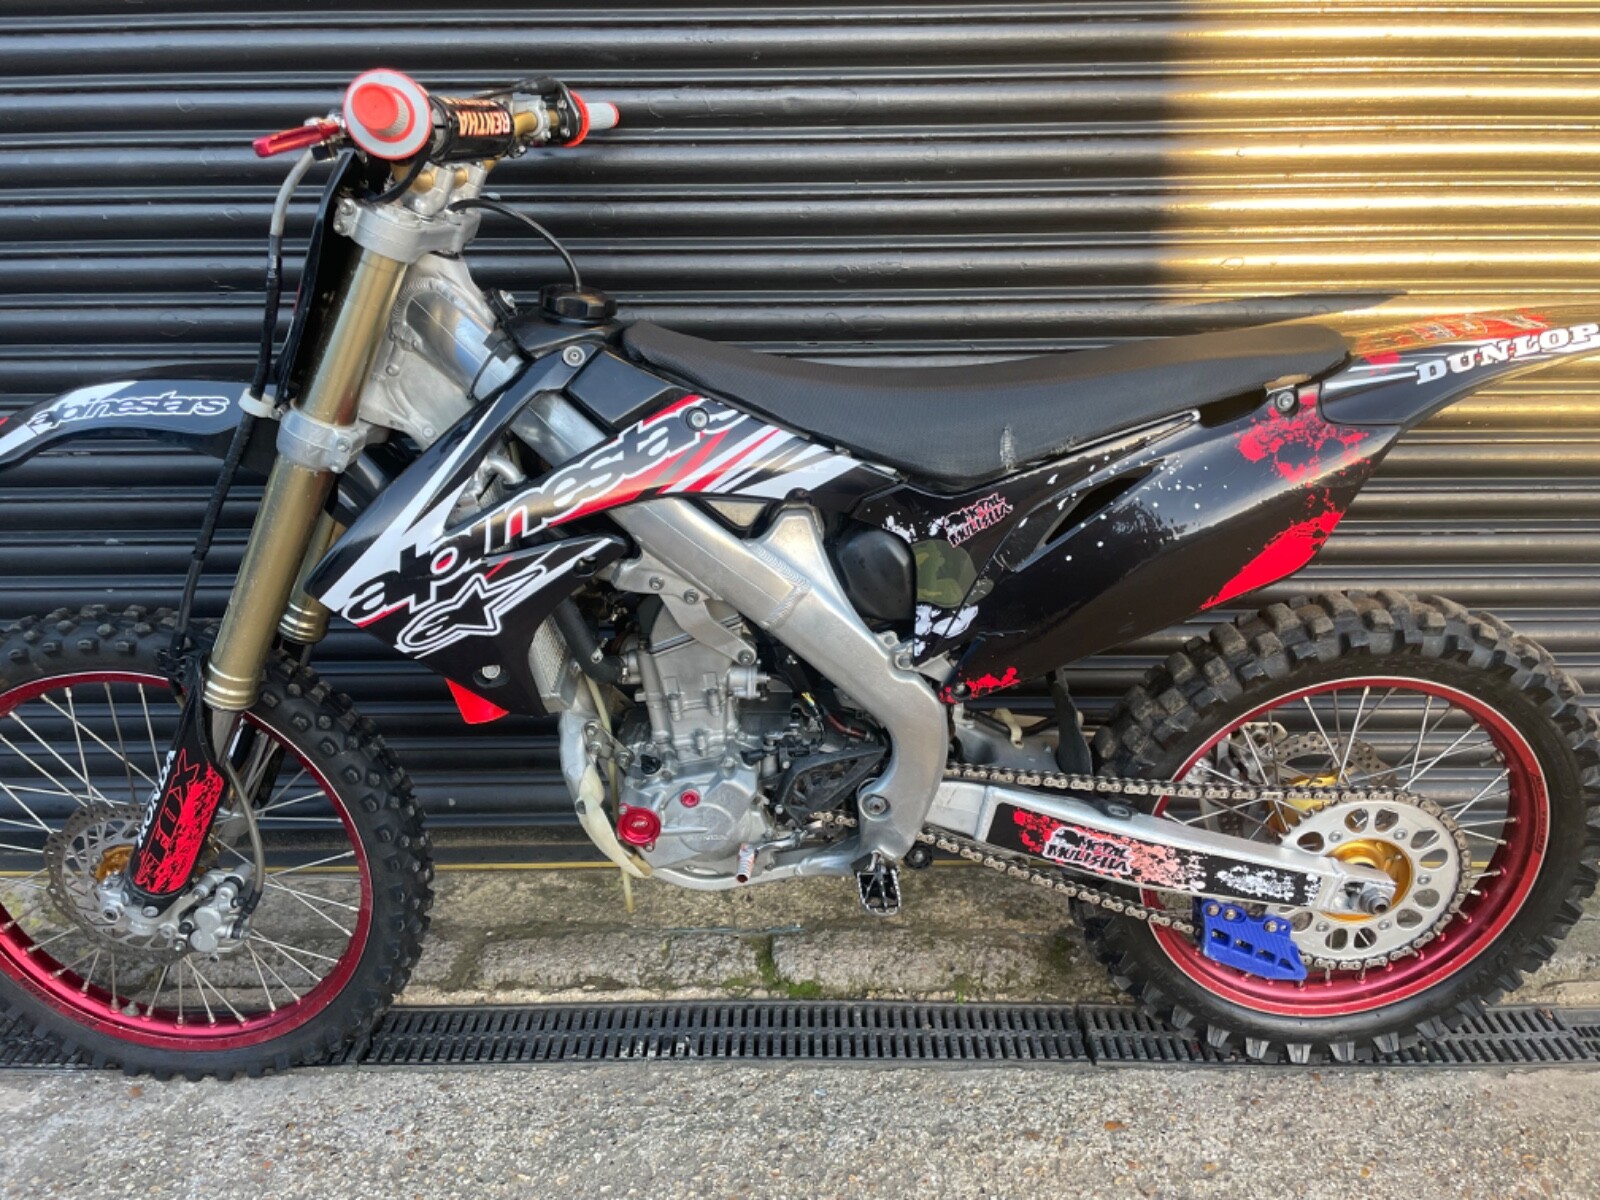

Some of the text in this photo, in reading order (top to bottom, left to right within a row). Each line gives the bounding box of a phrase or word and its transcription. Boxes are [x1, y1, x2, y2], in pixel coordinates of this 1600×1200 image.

[455, 110, 511, 136] RENTHA
[1416, 323, 1599, 385] DUNLOP
[138, 750, 176, 847] HONDA
